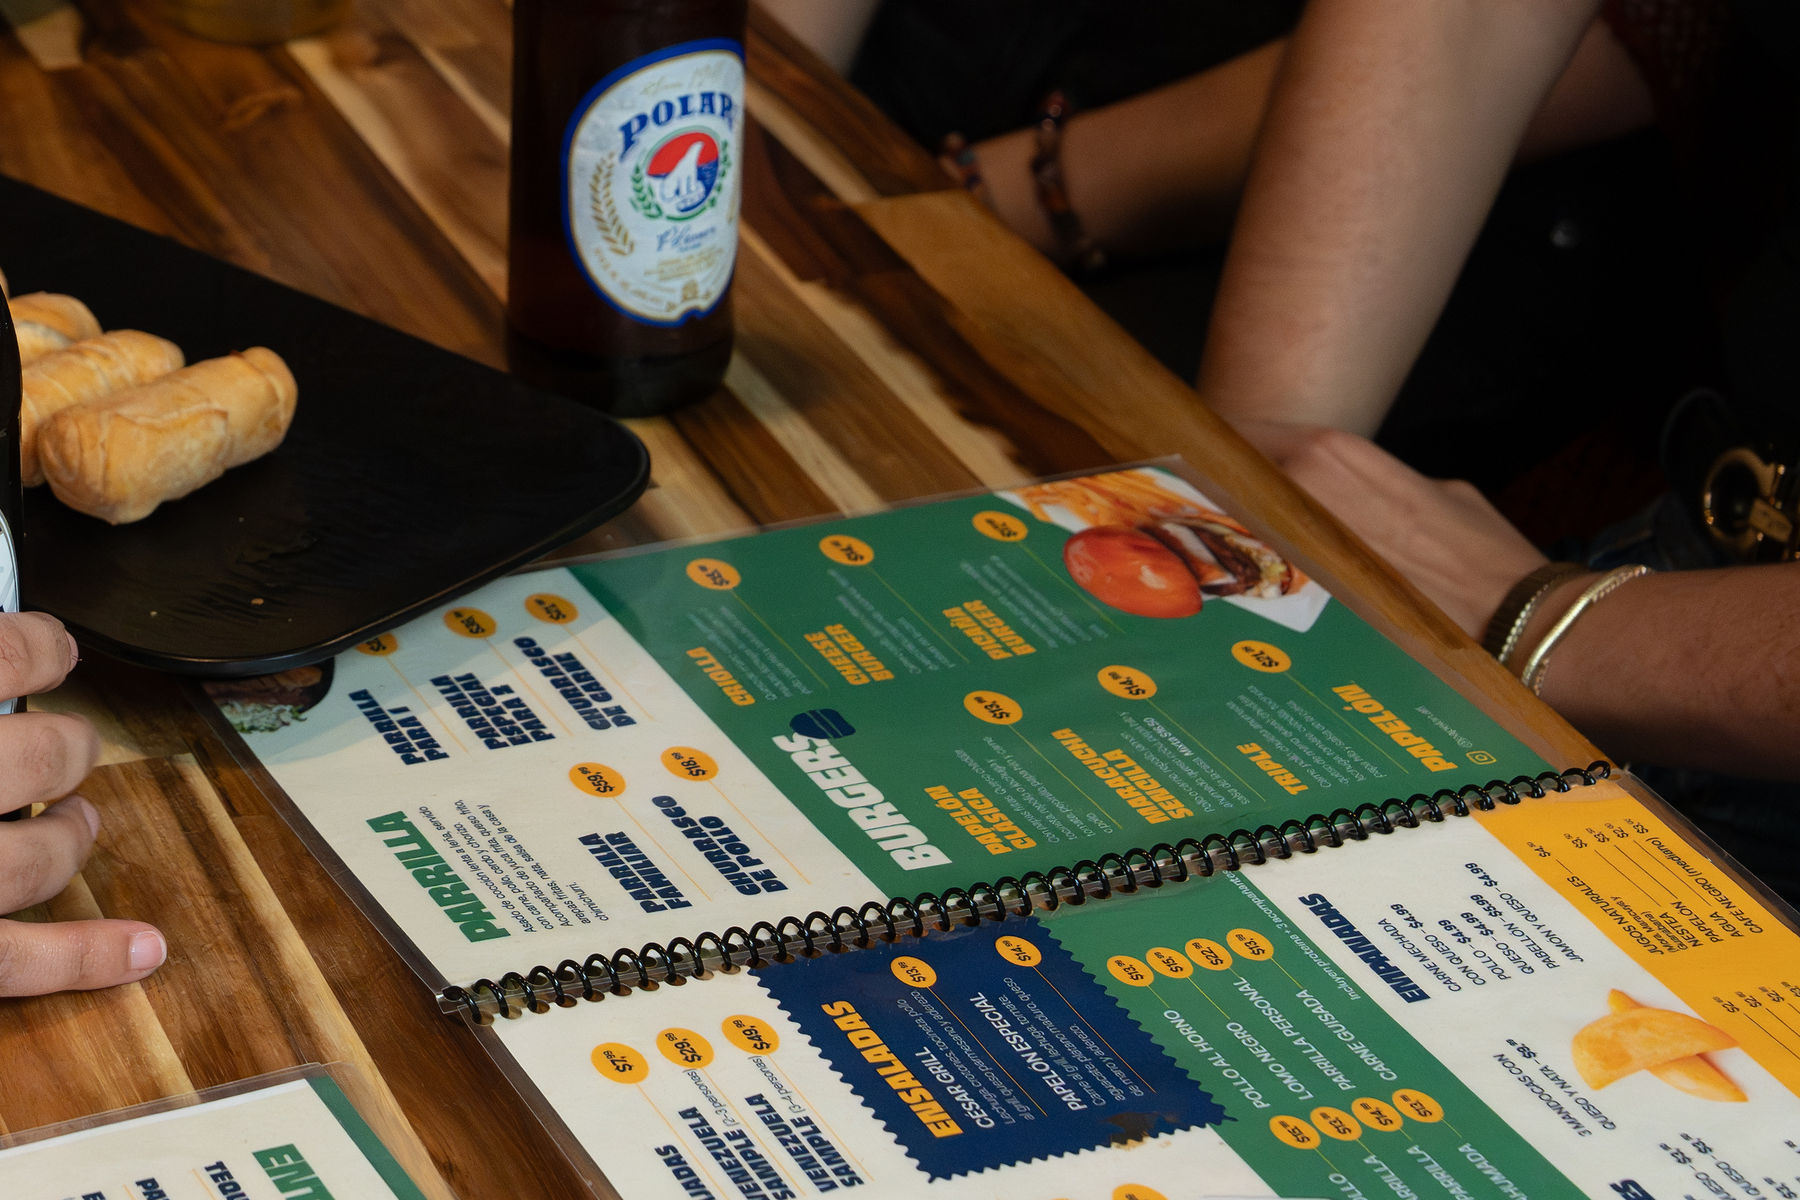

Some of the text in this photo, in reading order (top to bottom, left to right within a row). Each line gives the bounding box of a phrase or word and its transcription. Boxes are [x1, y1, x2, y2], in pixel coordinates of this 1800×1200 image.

[618, 91, 735, 163] POLAR
[804, 631, 870, 685] CHEESE
[824, 623, 894, 681] BURGER
[942, 606, 1013, 660] PICAÑA
[963, 599, 1036, 655] BURGER
[513, 636, 611, 730] CHURRASCO
[553, 651, 637, 727] DE CARNE
[686, 646, 755, 706] CRIOLLA
[348, 688, 426, 765] PARRILLA
[387, 705, 450, 761] PARA 1
[430, 674, 509, 749] PARRILLA
[454, 672, 532, 745] ESPECIAL
[486, 684, 555, 742] PARA 2
[1333, 683, 1457, 772] PAPELÓN
[773, 728, 951, 870] BURGERS
[1052, 728, 1170, 824] MARACUCHA
[1102, 748, 1194, 819] SENCILLA
[1236, 742, 1308, 795] TRIPLE
[481, 808, 502, 826] casa
[503, 833, 518, 844] de
[652, 795, 761, 895] CHURRASCO
[924, 784, 1012, 855] PAPELÓN
[958, 786, 1037, 849] CLÁSICA
[367, 810, 510, 942] PARRILLA
[418, 805, 537, 932] Asado de cocción lenta leña, servido
[453, 822, 555, 930] con carne, pollo, cerdo chorizo.
[454, 798, 574, 927] Acompañado de yuca frita, queso frito,
[512, 843, 535, 862] salsa
[530, 861, 550, 880] nata,
[578, 832, 668, 913] PARRILLA
[605, 831, 692, 909] FAMILIAR
[698, 815, 789, 893] DE POLLO
[1464, 861, 1498, 887] $4.99
[1645, 836, 1764, 933] CAFÉ NEGRO (mediano)
[546, 879, 569, 900] fritas,
[563, 899, 592, 924] arepas
[568, 881, 609, 921] chimichurri.
[1499, 892, 1538, 923] QUESO
[1566, 874, 1665, 955] JUGOS NATURALES
[1670, 900, 1724, 943] PAPELÓN
[1298, 892, 1430, 1003] EMPANADAS
[1377, 917, 1462, 992] CARNE MECHADA
[1390, 902, 1487, 985] CON QUESO $4.99
[1437, 918, 1512, 980] POLLO $4.99
[1460, 911, 1535, 974] QUESO $4.99
[1503, 922, 1560, 969] PABELLÓN
[1540, 928, 1584, 962] JAMÓN
[1659, 911, 1704, 947] NESTEA
[1709, 910, 1744, 937] AGUA
[896, 998, 923, 1017] pollo
[1003, 976, 1031, 1001] queso
[1233, 975, 1300, 1037] PERSONAL
[1322, 965, 1361, 1000] Incluyen
[969, 991, 1088, 1110] PAPELÓN ESPECIAL
[1163, 1009, 1271, 1108] POLLO AL HORNO
[1225, 1021, 1314, 1100] LOMO NEGRO
[1292, 1035, 1356, 1090] PARRILLA
[1295, 988, 1398, 1080] CARNE GUISADA
[1492, 1052, 1523, 1075] CON
[822, 1000, 962, 1137] ENSALADAS
[915, 1045, 995, 1128] CÉSAR GRILL
[984, 1070, 1014, 1096] queso
[1078, 1079, 1107, 1106] Carne
[1539, 1064, 1617, 1130] QUESO NATA
[682, 1066, 796, 1200] SAMPLE personas)
[748, 1054, 864, 1187] SAMPLE personas)
[1517, 1074, 1584, 1129] MANDOCAS
[745, 1093, 838, 1192] VENEZUELA
